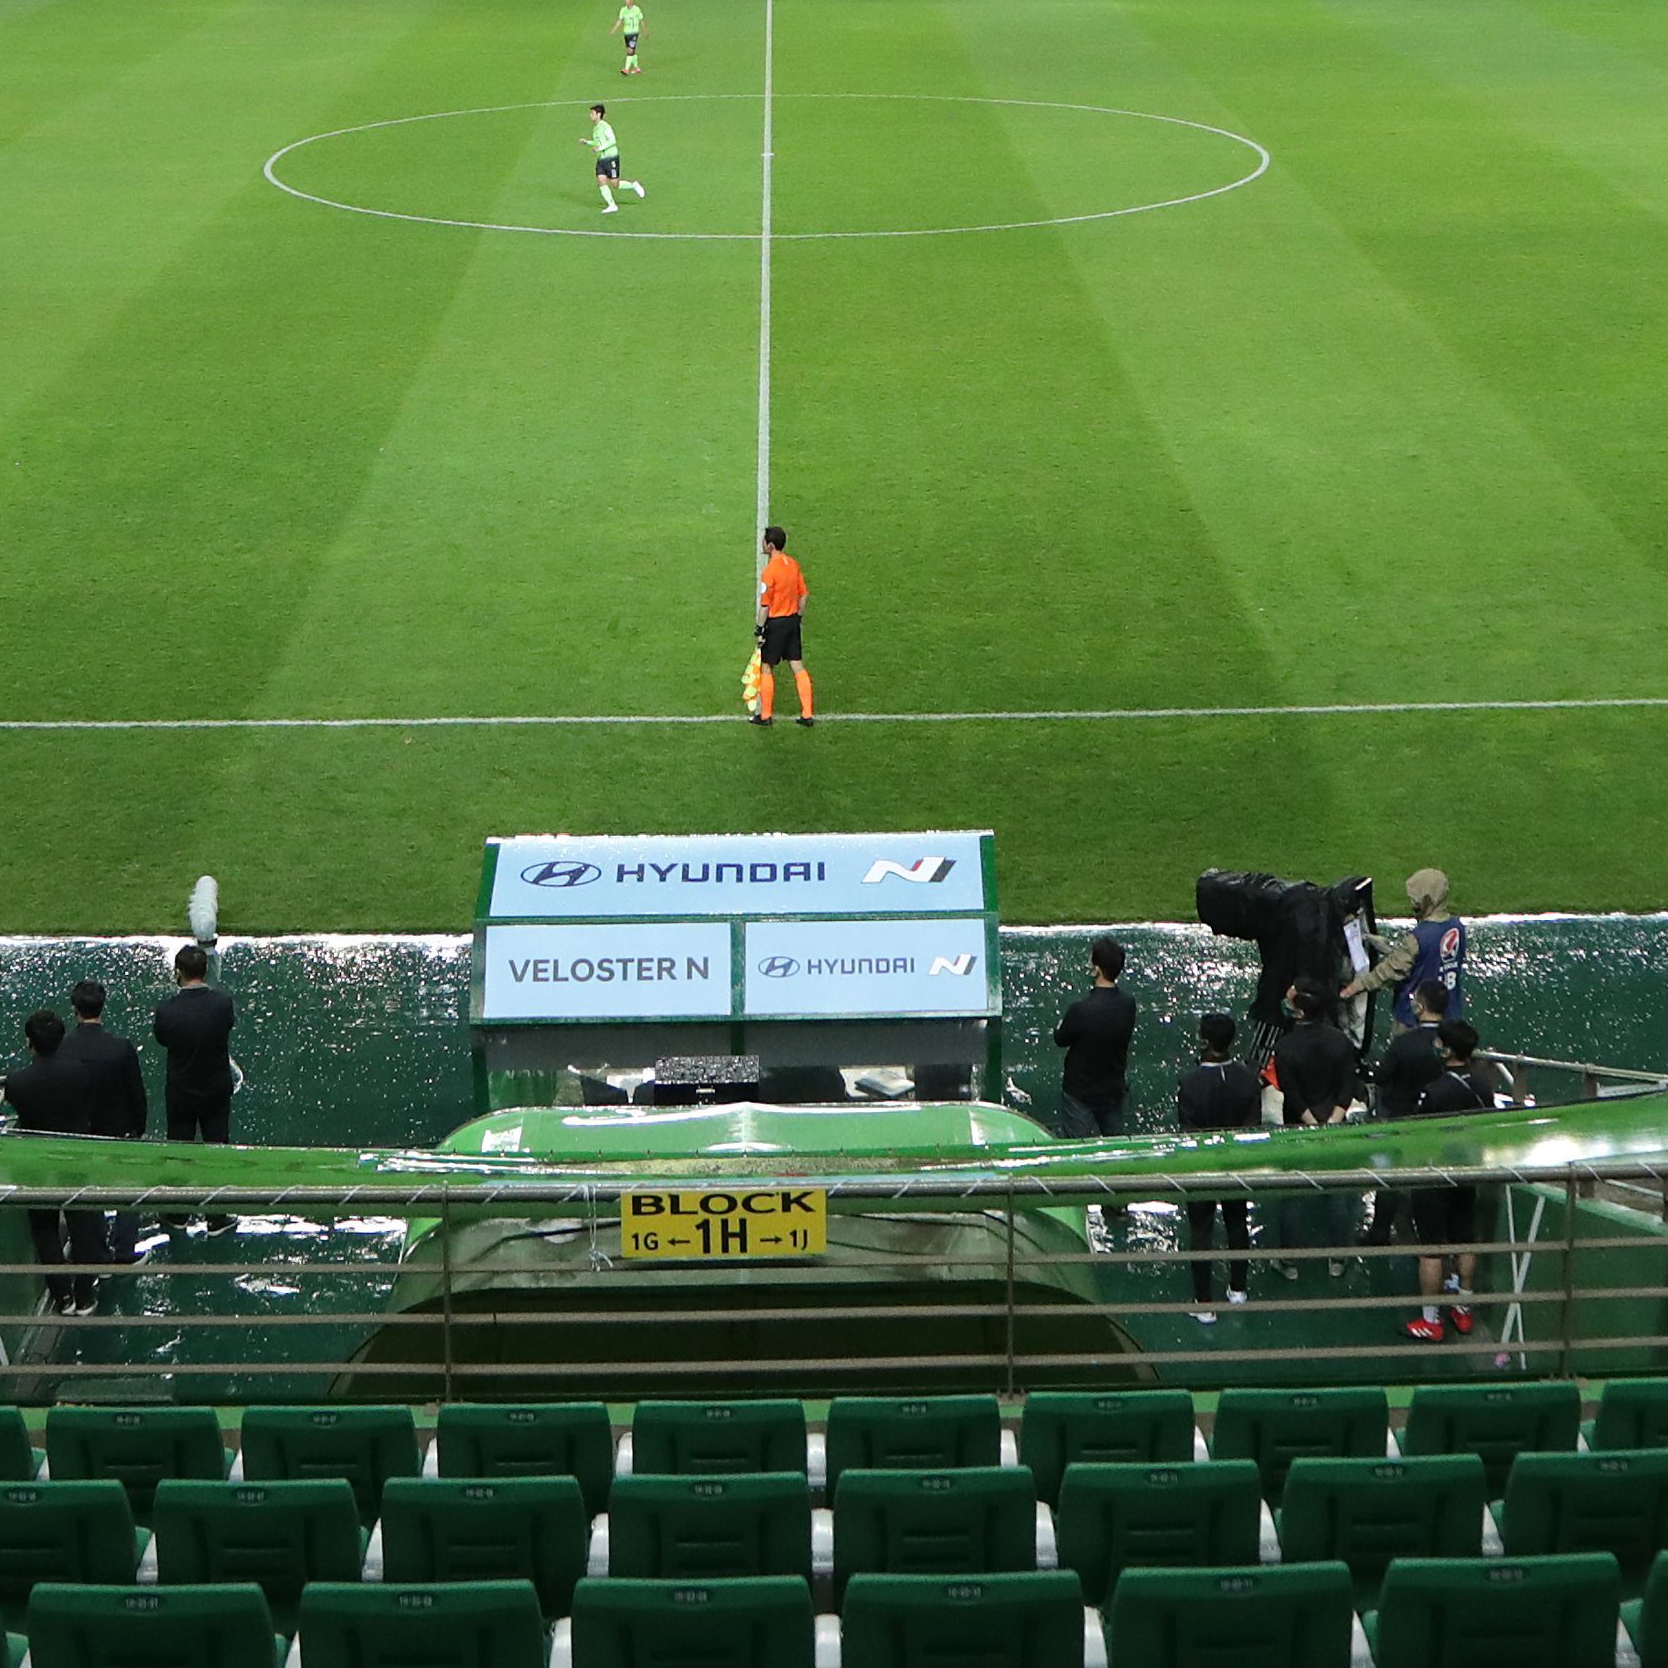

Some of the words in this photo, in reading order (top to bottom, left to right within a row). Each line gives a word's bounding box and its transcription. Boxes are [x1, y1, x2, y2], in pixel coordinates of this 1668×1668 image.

[616, 861, 826, 883] HYUNDAI
[509, 957, 677, 983] VELOSTER
[686, 957, 710, 981] N
[807, 957, 915, 974] HYUNDAI
[632, 1192, 816, 1215] BLOCK
[632, 1233, 658, 1251] 1G
[696, 1218, 748, 1254] 1H
[790, 1229, 808, 1251] 1J
